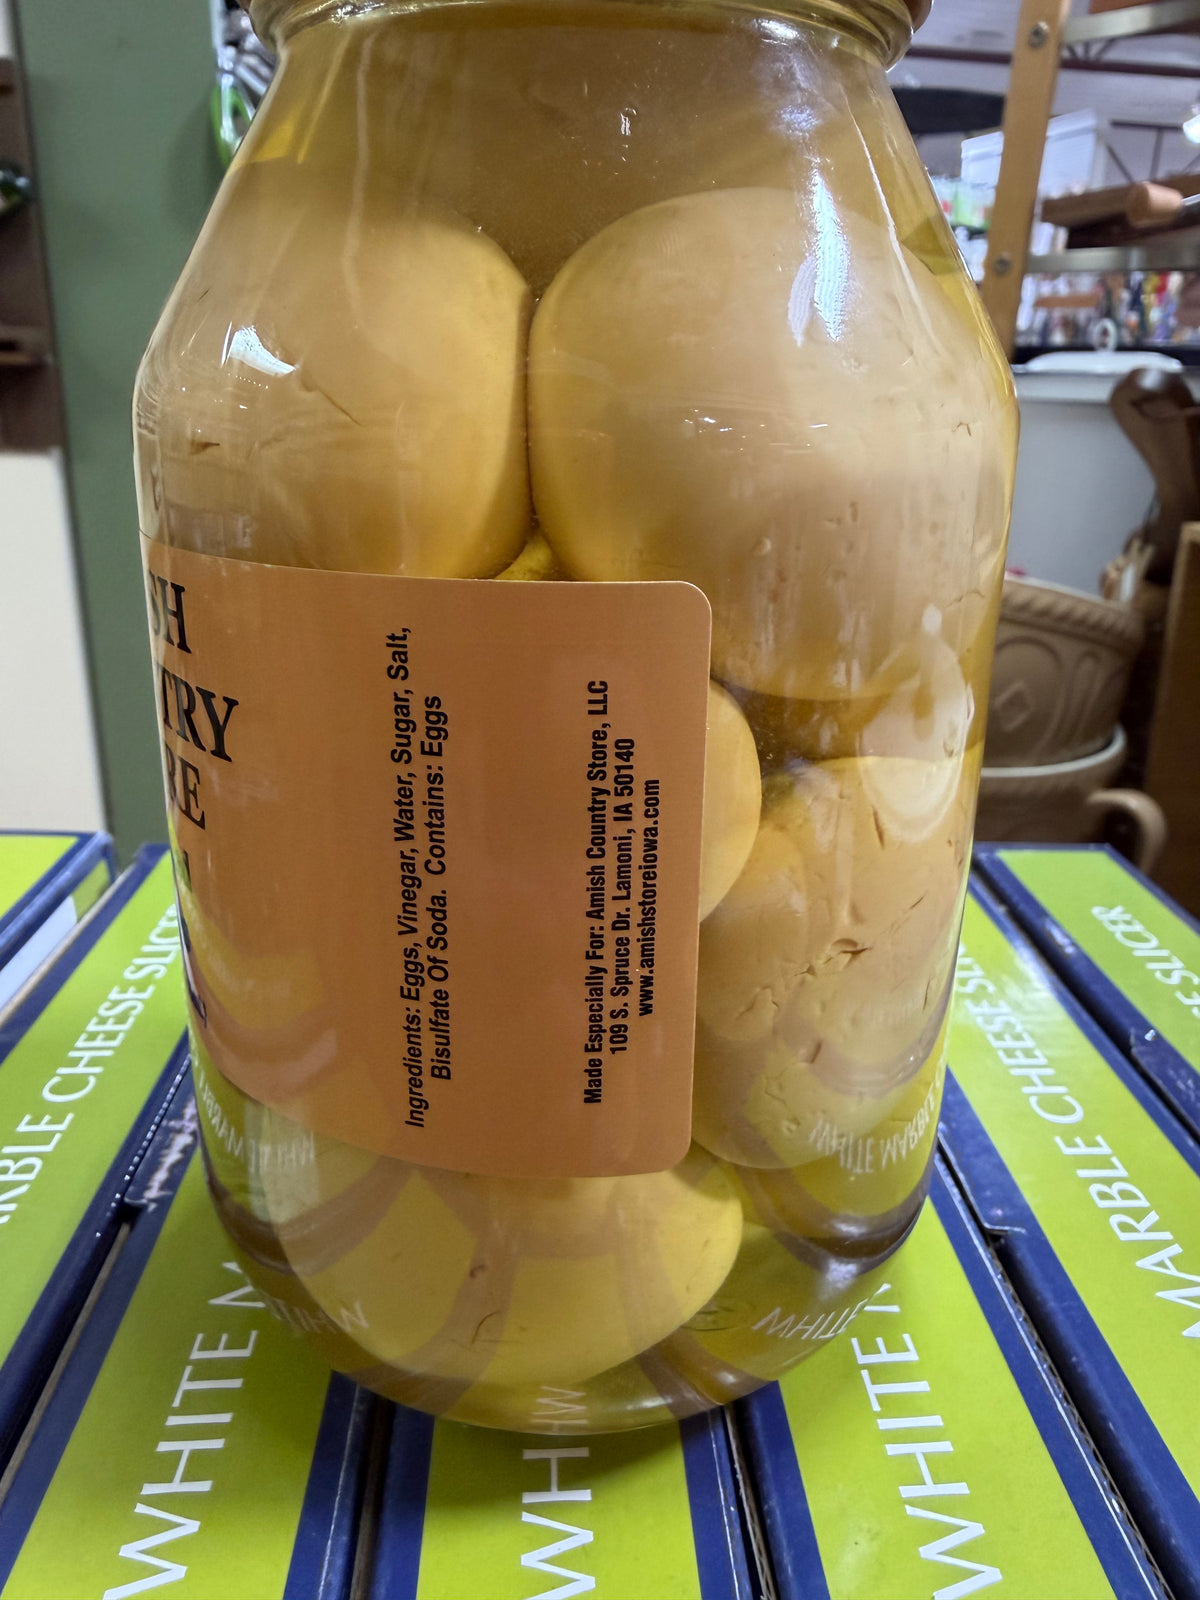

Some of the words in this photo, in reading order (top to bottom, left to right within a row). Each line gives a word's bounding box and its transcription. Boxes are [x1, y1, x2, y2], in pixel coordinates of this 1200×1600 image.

[386, 628, 411, 681] Salt,
[390, 689, 417, 765] Sugar,
[420, 696, 449, 757] Eggs
[587, 681, 608, 715] LLC
[586, 723, 611, 781] Store,
[613, 739, 635, 797] 50140
[393, 772, 417, 842] Water,
[422, 765, 446, 875] Contains:
[586, 787, 611, 859] Country
[613, 802, 633, 822] IA
[397, 848, 422, 936] Vinegar,
[585, 865, 605, 920] Amish
[612, 829, 636, 901] Lamoni,
[425, 890, 448, 951] Soda.
[611, 912, 630, 931] Dr.
[636, 780, 660, 1016] www.amishstoreiowa.com
[400, 942, 425, 1001] Eggs,
[427, 955, 449, 982] Of
[585, 926, 605, 960] For:
[610, 947, 633, 997] Spruce
[1091, 905, 1200, 985] SLICER
[429, 989, 451, 1080] Bisulfate
[584, 965, 608, 1053] Especially
[609, 1002, 629, 1019] S.
[609, 1024, 628, 1055] 109
[41, 984, 155, 1102] CHEESE
[402, 1007, 429, 1128] Ingredients:
[963, 1000, 1085, 1125] CHEESE
[583, 1058, 603, 1104] Made
[102, 1330, 259, 1600] WHITE
[850, 1333, 1003, 1600] WHITE
